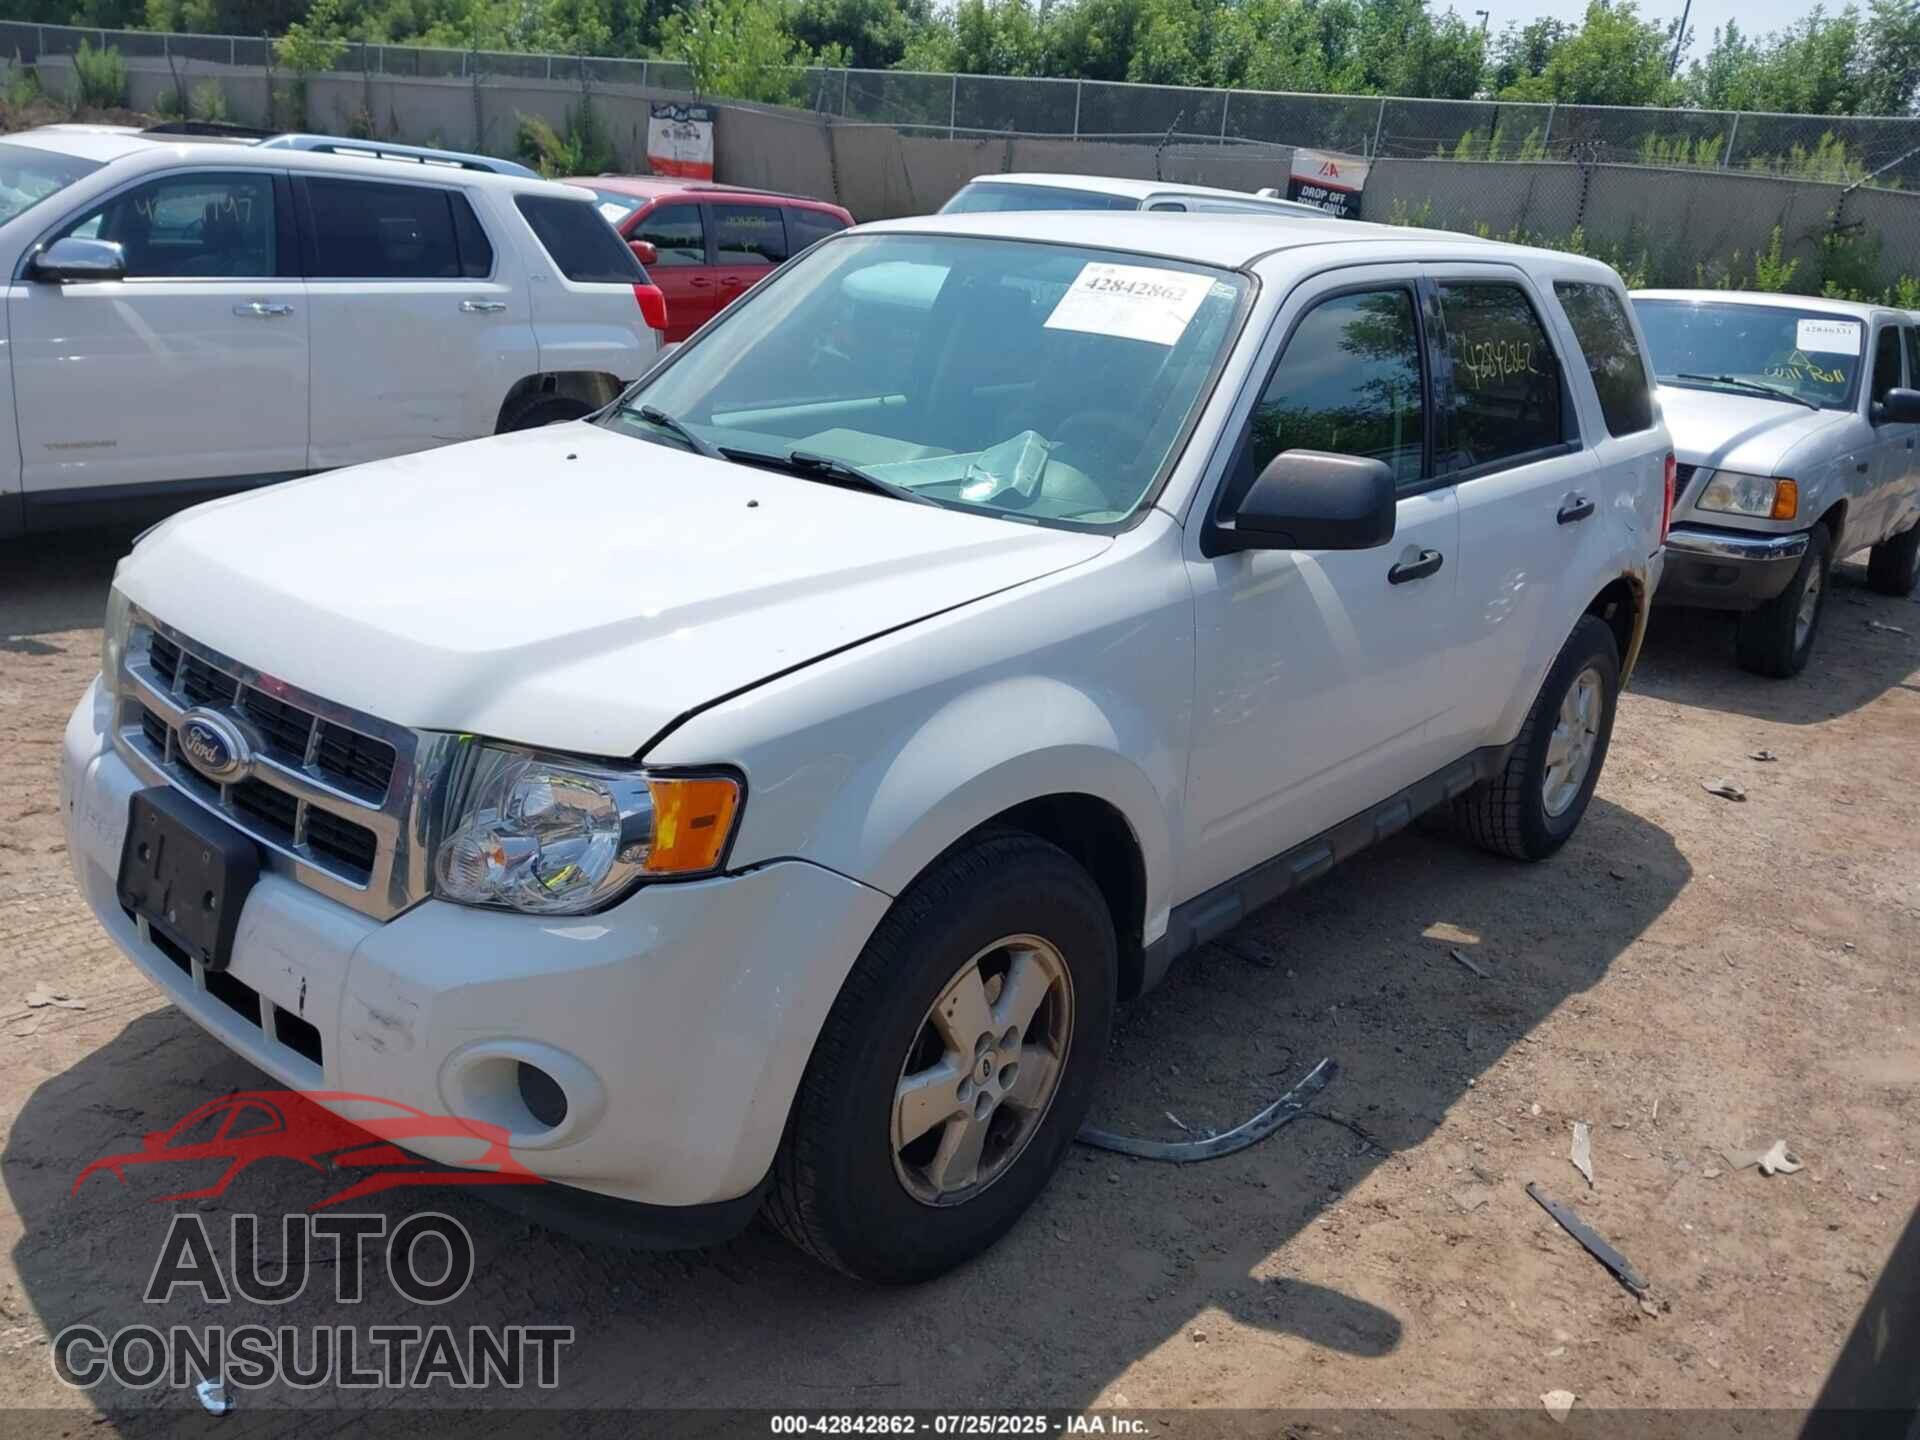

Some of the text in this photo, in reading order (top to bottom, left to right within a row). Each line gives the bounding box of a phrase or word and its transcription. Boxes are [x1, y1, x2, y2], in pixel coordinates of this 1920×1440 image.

[1301, 186, 1346, 204] DROP OFF
[1322, 202, 1348, 215] ONLY
[1085, 278, 1188, 301] 42842862
[186, 726, 218, 762] Ford
